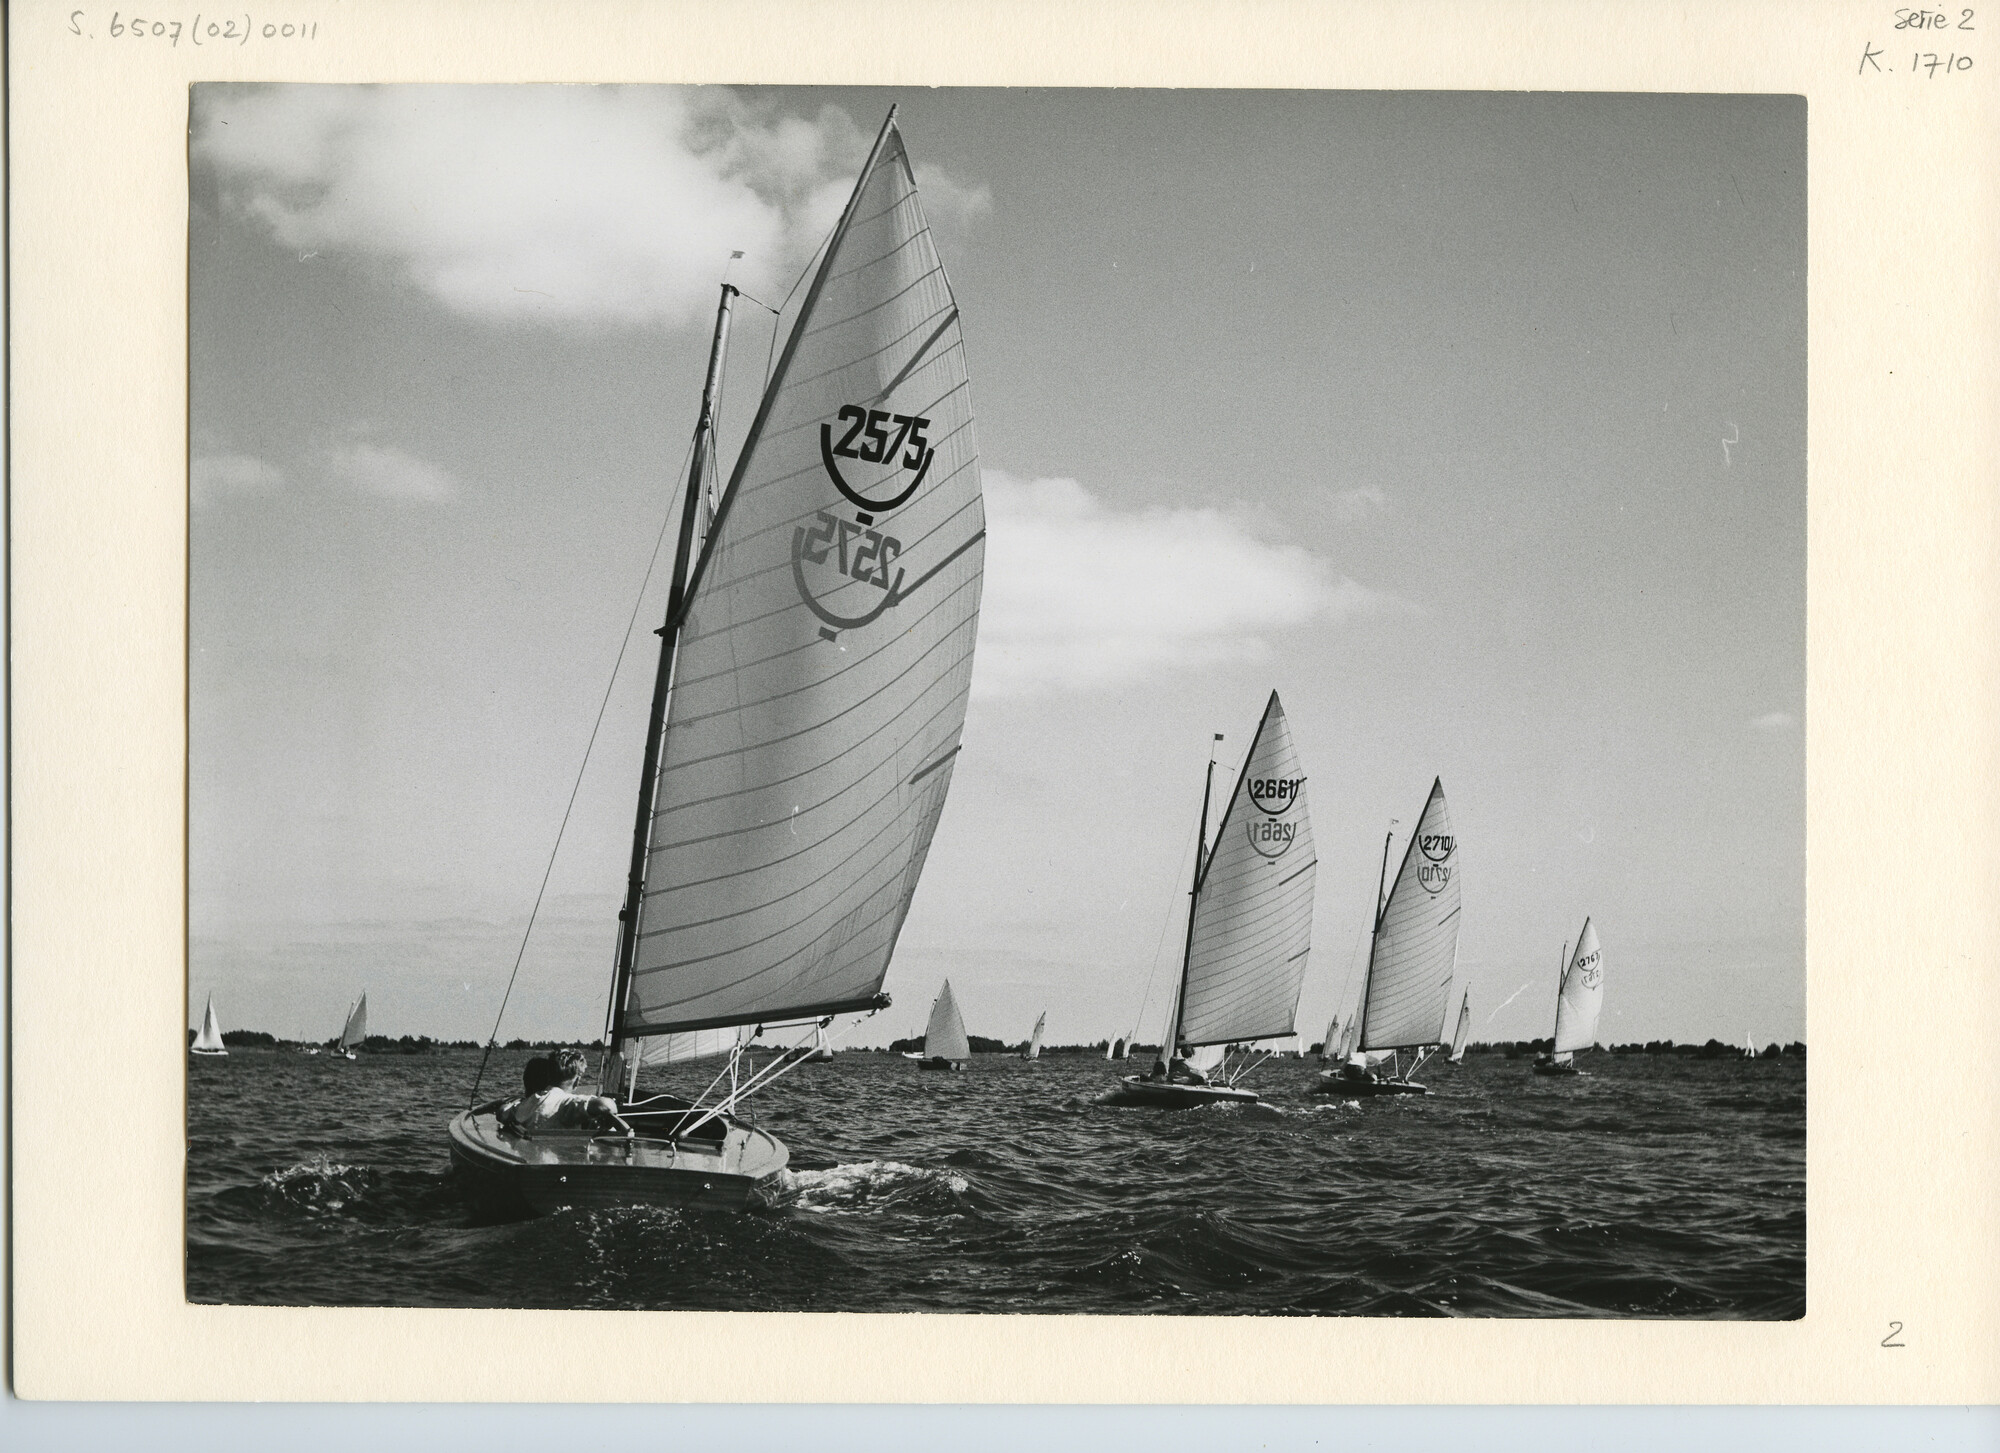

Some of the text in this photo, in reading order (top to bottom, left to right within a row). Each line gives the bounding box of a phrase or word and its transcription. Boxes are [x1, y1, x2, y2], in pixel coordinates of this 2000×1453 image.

[67, 10, 94, 39] S.
[1957, 8, 1975, 31] 2
[1911, 52, 1974, 79] 1710
[832, 404, 931, 471] 2575
[1253, 779, 1295, 800] 2661
[1423, 834, 1451, 851] 2710
[1880, 1320, 1906, 1348] 2
